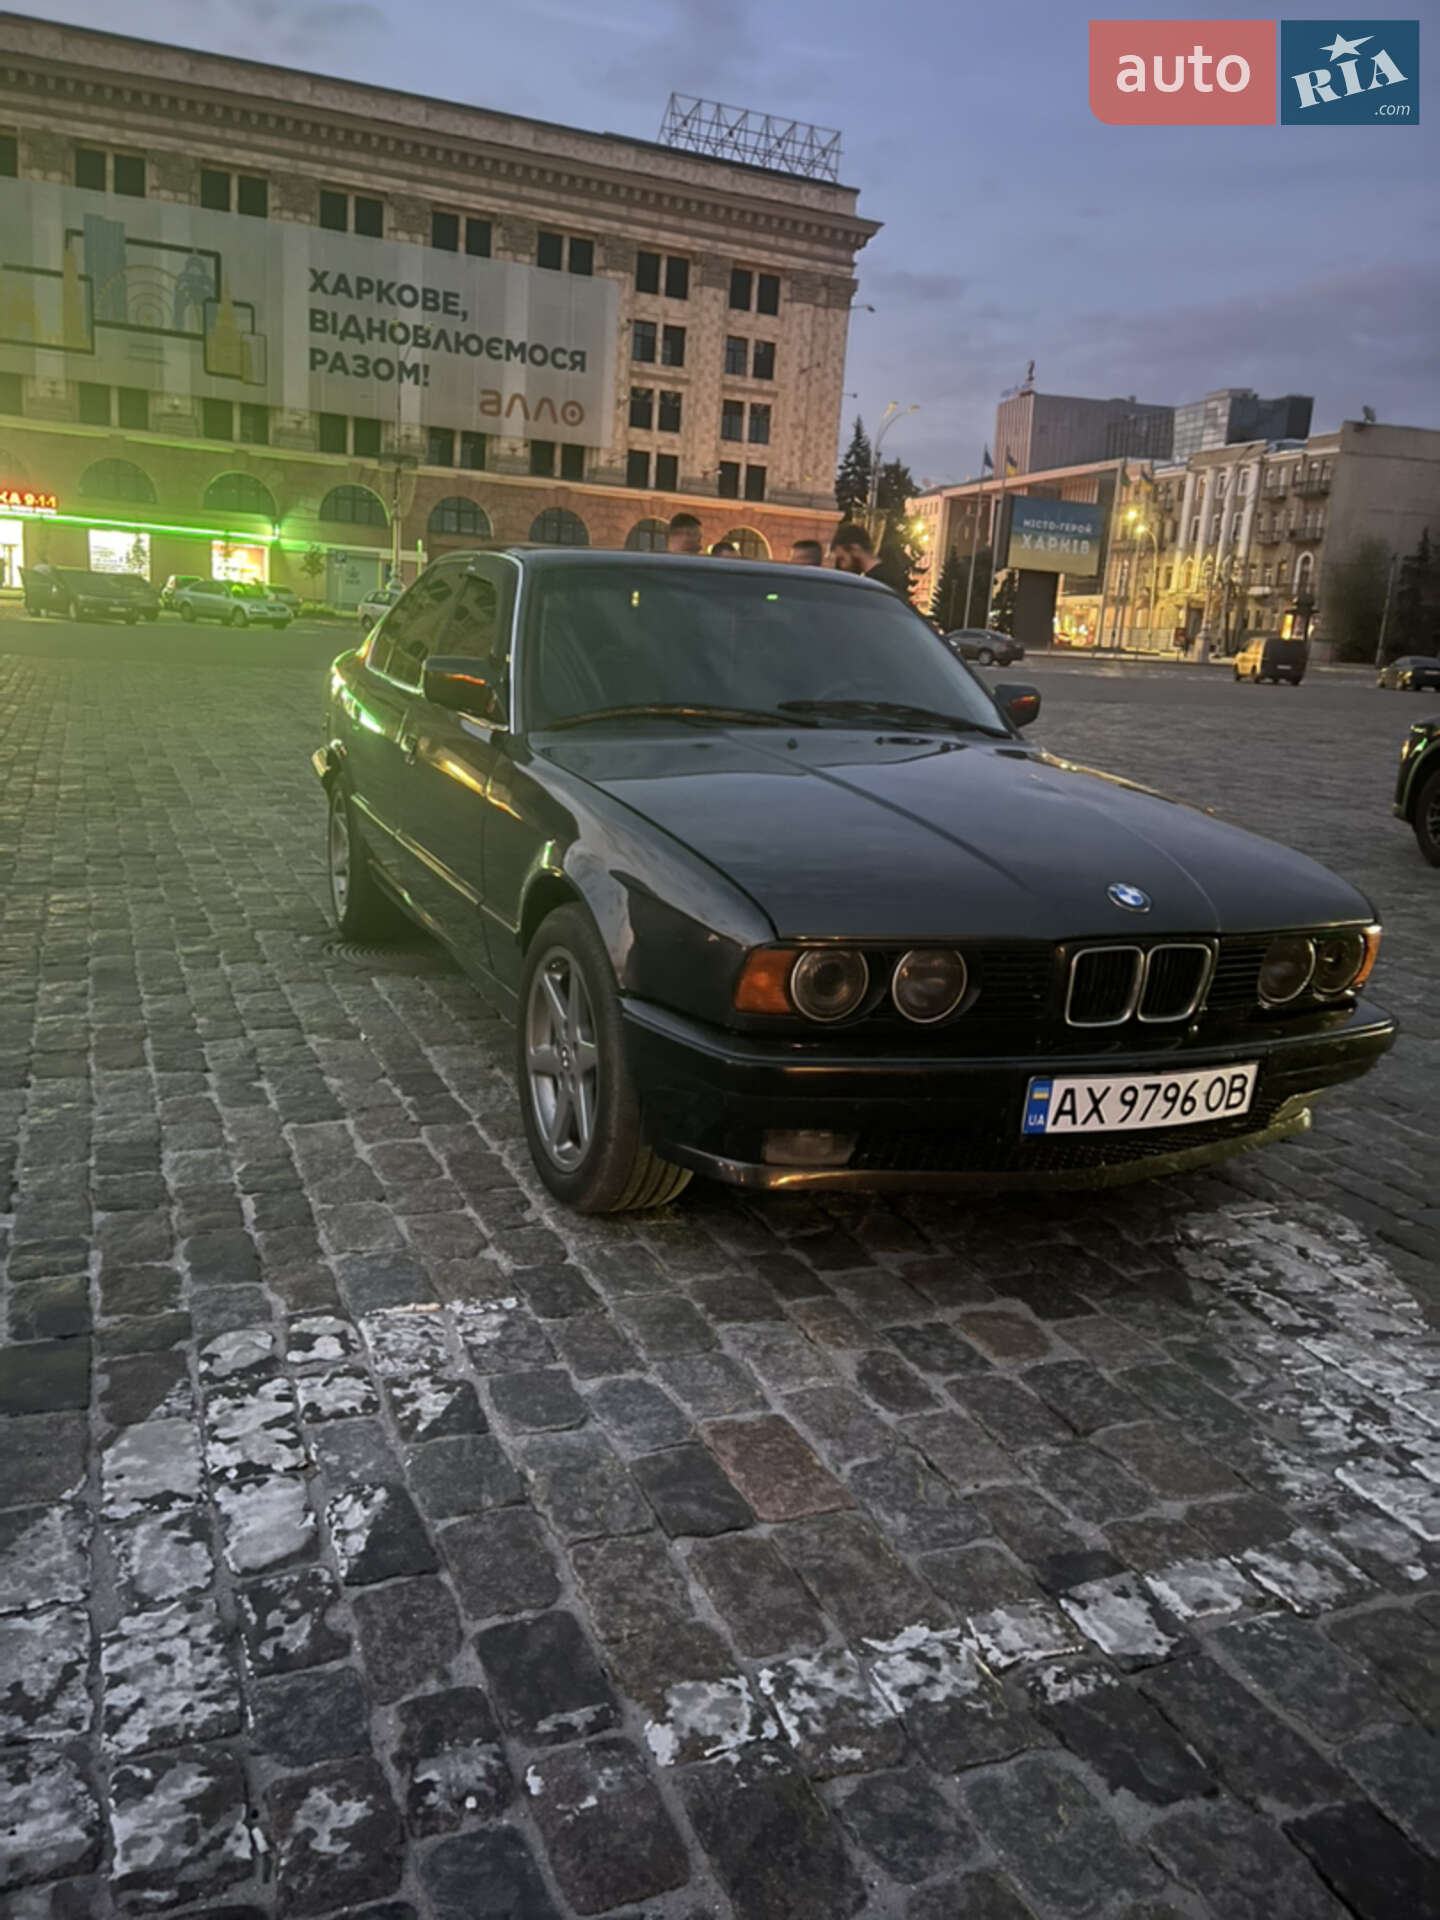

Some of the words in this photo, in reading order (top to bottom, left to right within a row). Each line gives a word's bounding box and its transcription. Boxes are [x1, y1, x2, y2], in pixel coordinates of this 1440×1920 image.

[308, 267, 469, 322] ХАРКОВЕ,
[308, 307, 587, 373] ВІДНОВЛЮЄМОСЯ
[308, 346, 431, 387] РАЗОМ!
[1022, 533, 1090, 555] ХАРКІВ
[1028, 1113, 1045, 1127] UA
[1051, 1086, 1112, 1126] AX
[1117, 1078, 1200, 1124] 9796
[1205, 1073, 1249, 1113] OB
